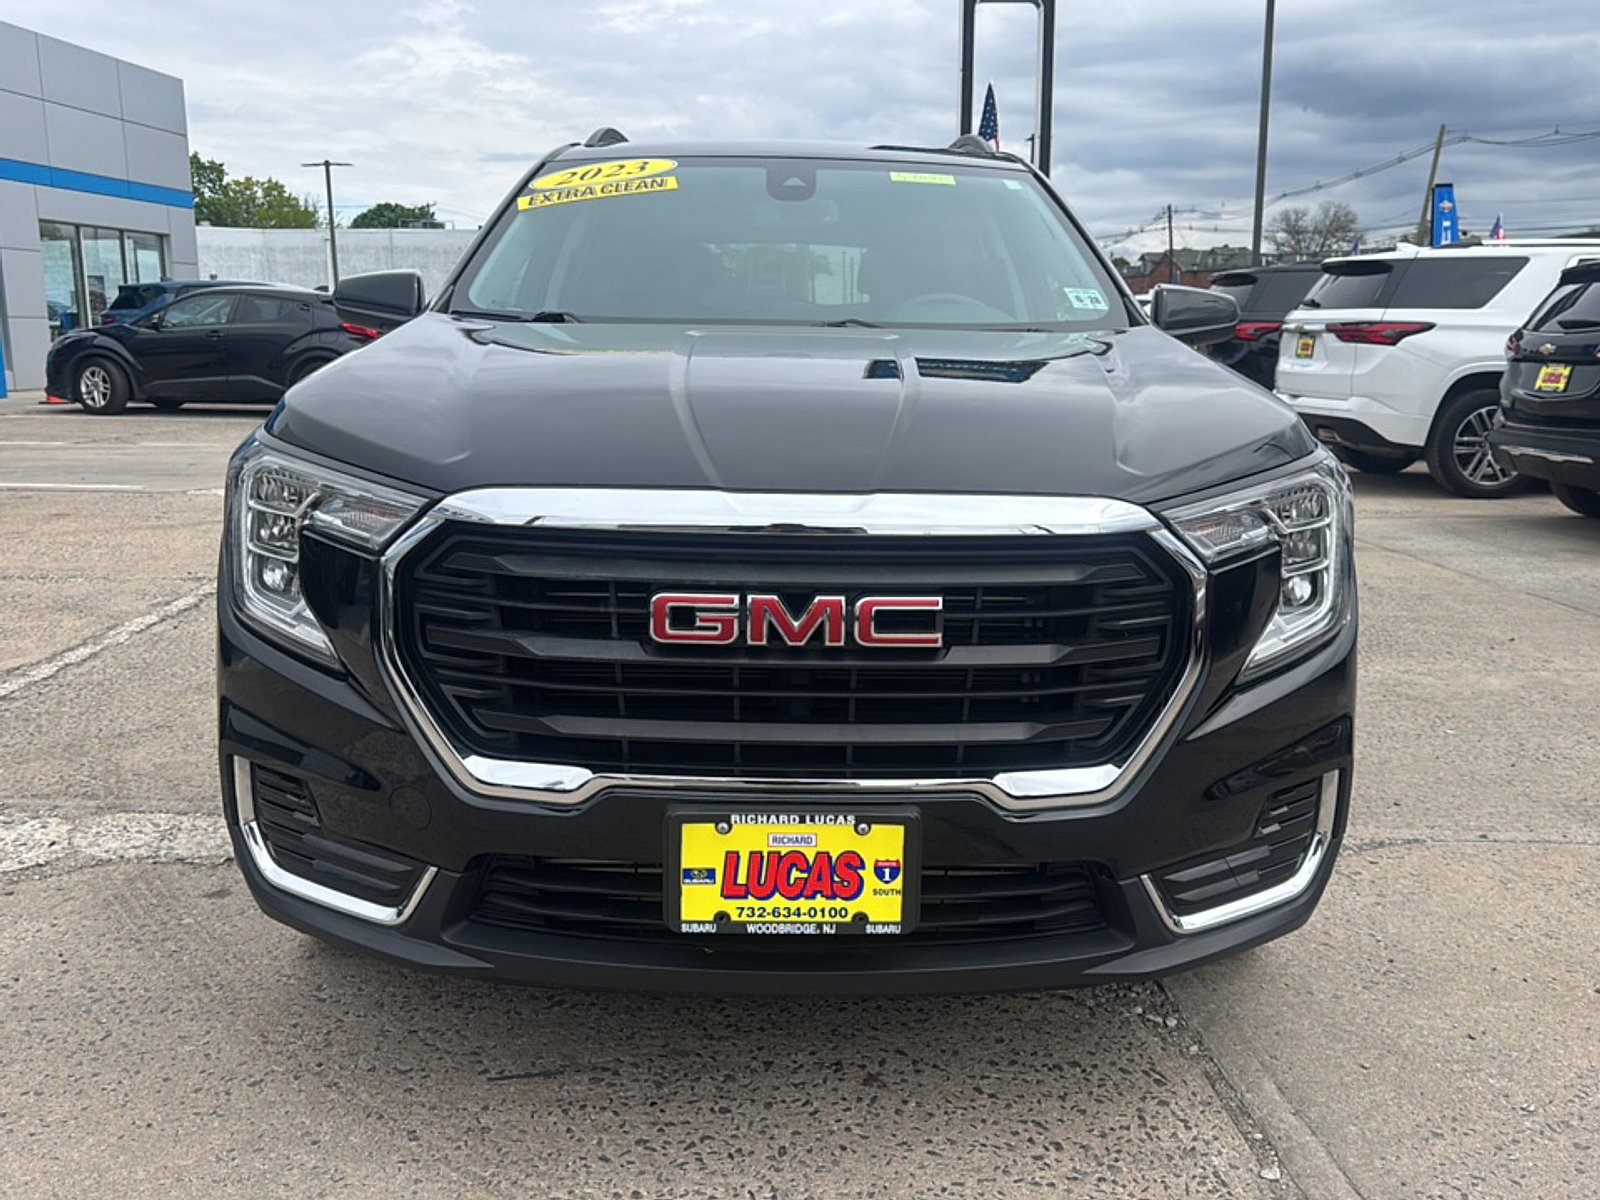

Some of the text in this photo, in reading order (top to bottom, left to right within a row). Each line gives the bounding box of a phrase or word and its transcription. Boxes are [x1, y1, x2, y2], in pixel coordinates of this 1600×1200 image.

[555, 161, 649, 186] 2023
[527, 178, 664, 207] EXTRA CLEAN
[650, 593, 943, 648] GMC
[731, 814, 856, 826] RICHARD LUCAS
[771, 834, 814, 846] RICHARD
[721, 850, 866, 901] LUCAS
[882, 868, 893, 882] 1
[873, 888, 901, 897] SOUTH
[736, 906, 849, 918] 732-634-0100
[681, 923, 717, 933] SUBARU
[823, 923, 837, 935] NJ
[865, 924, 901, 935] SUBARU
